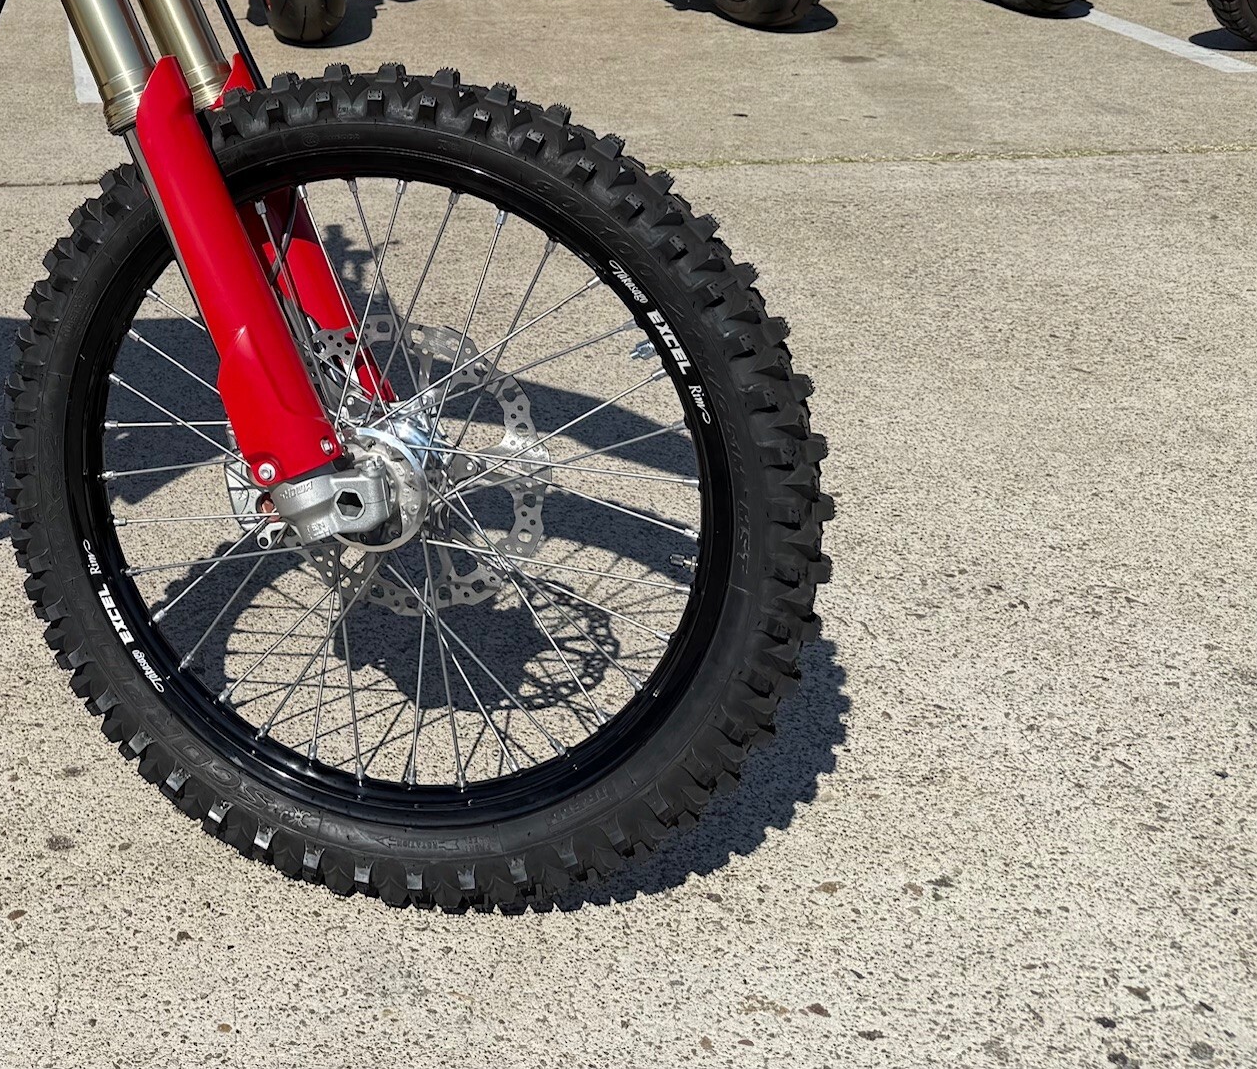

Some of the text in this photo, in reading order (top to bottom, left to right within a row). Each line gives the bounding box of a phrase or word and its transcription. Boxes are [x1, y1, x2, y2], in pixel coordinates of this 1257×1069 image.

[609, 259, 711, 425] Takasago EXCEL Rim
[83, 539, 102, 575] Rim
[98, 583, 134, 645] EXCEL
